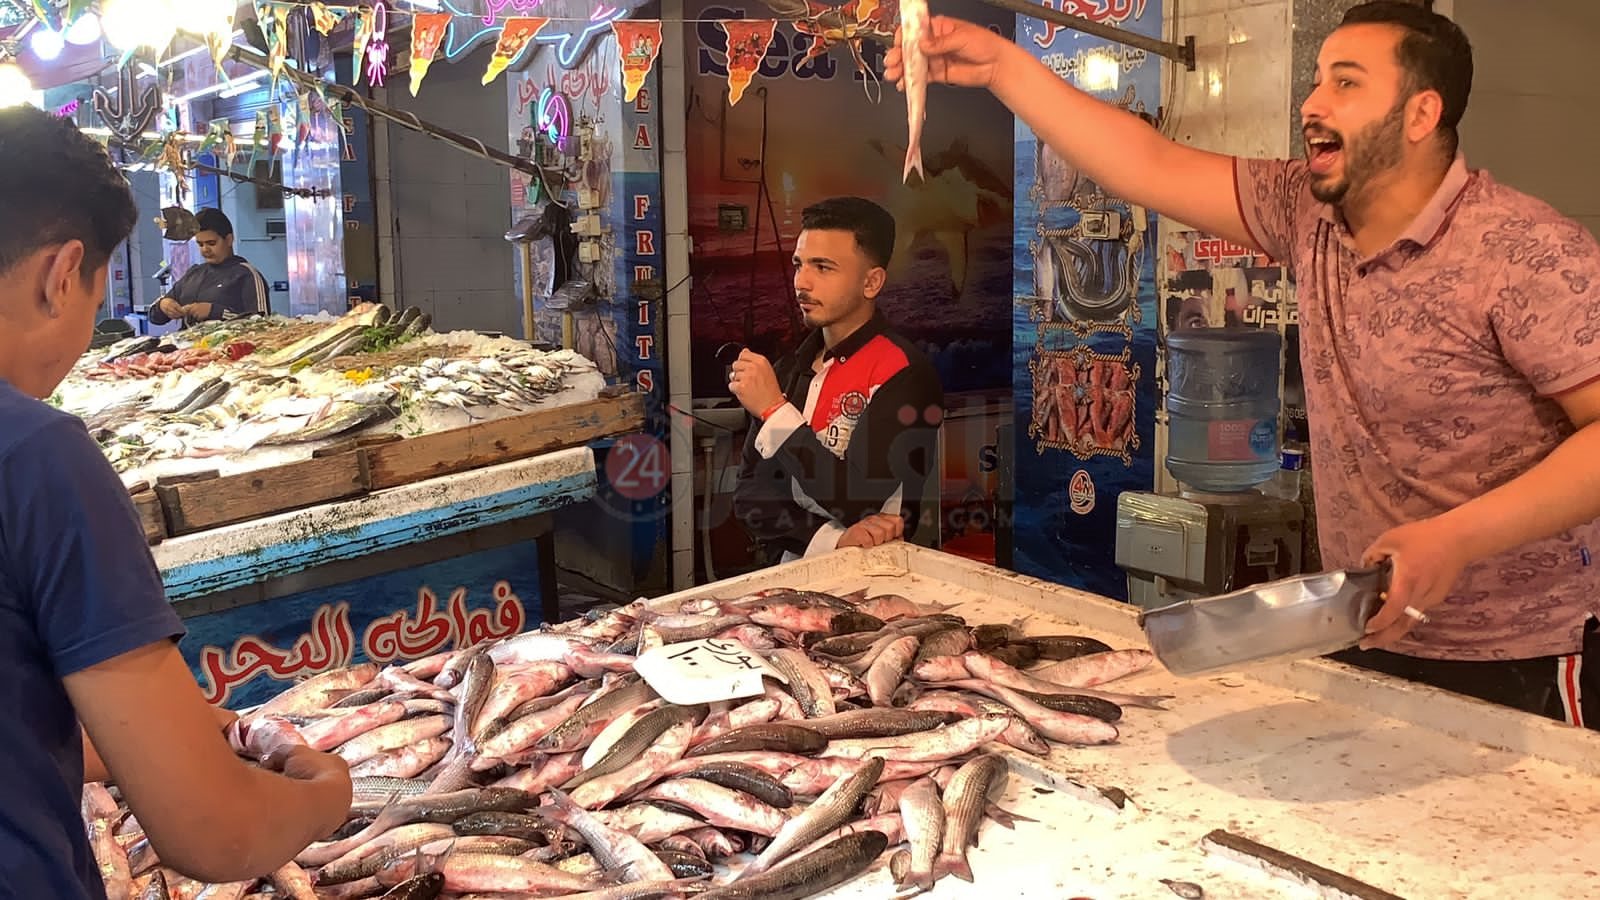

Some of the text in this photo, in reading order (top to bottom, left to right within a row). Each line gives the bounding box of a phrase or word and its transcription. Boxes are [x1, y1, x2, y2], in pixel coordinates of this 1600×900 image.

[697, 5, 836, 81] Sea
[633, 87, 652, 150] EA
[202, 581, 525, 707] فواكه البحر
